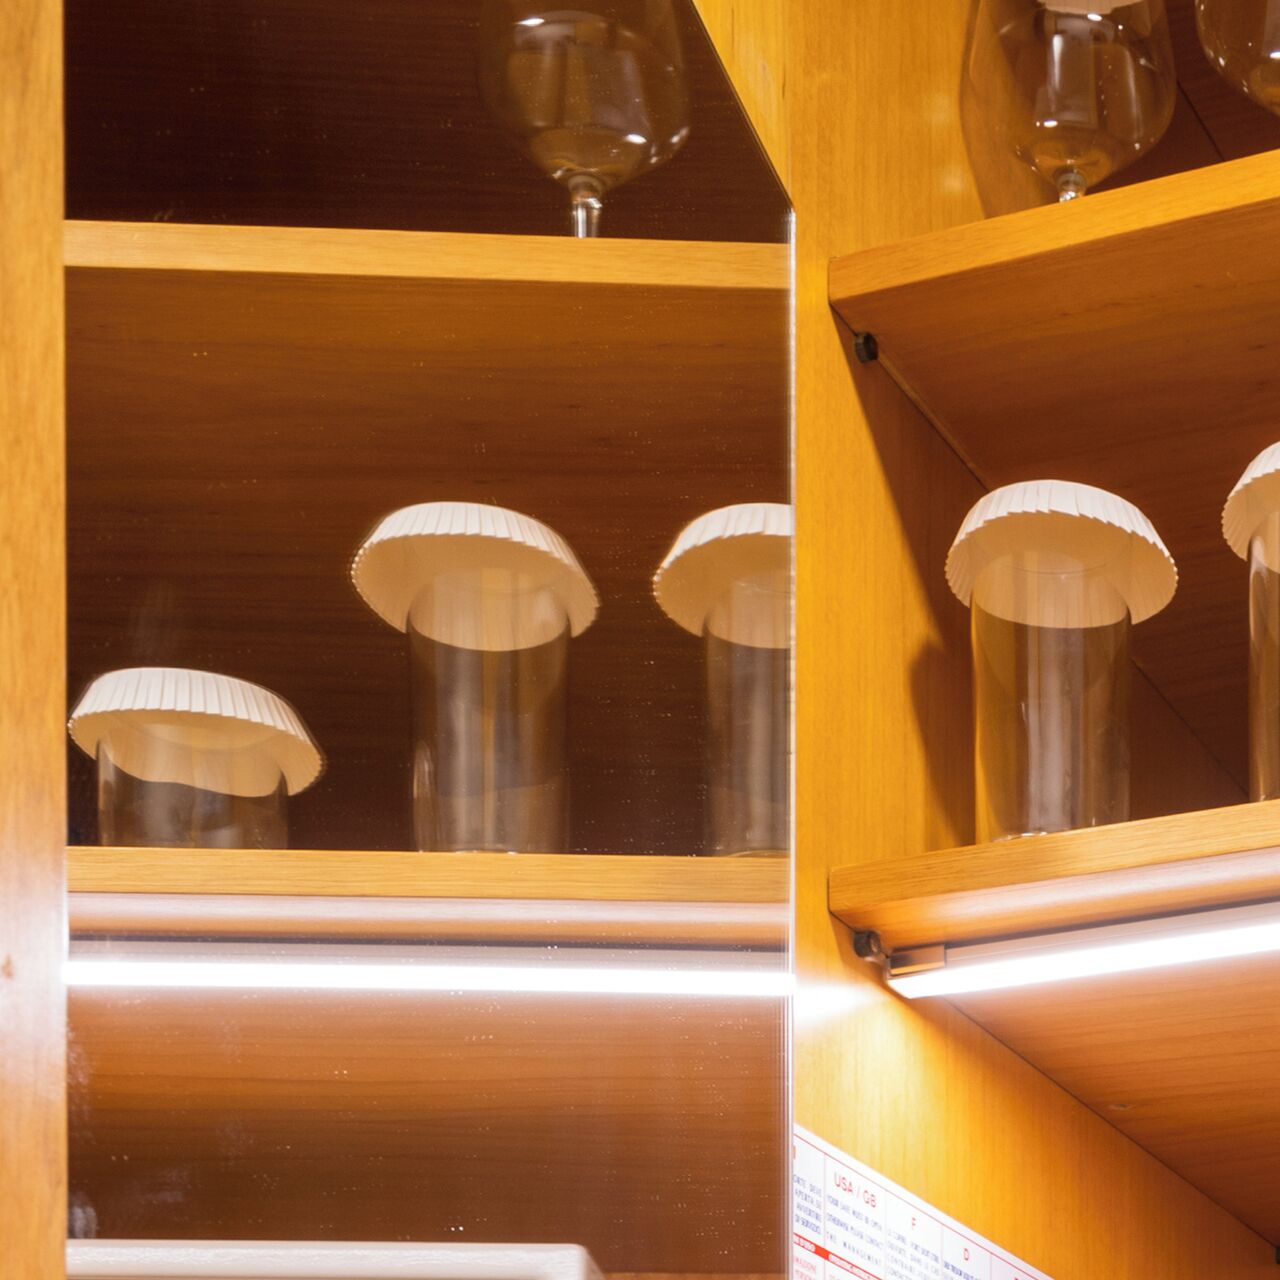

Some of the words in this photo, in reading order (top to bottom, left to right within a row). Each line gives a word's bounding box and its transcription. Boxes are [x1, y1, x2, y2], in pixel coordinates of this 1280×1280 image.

[834, 1172, 854, 1193] USA
[863, 1189, 877, 1208] GB
[911, 1217, 917, 1230] F
[963, 1247, 970, 1261] D
